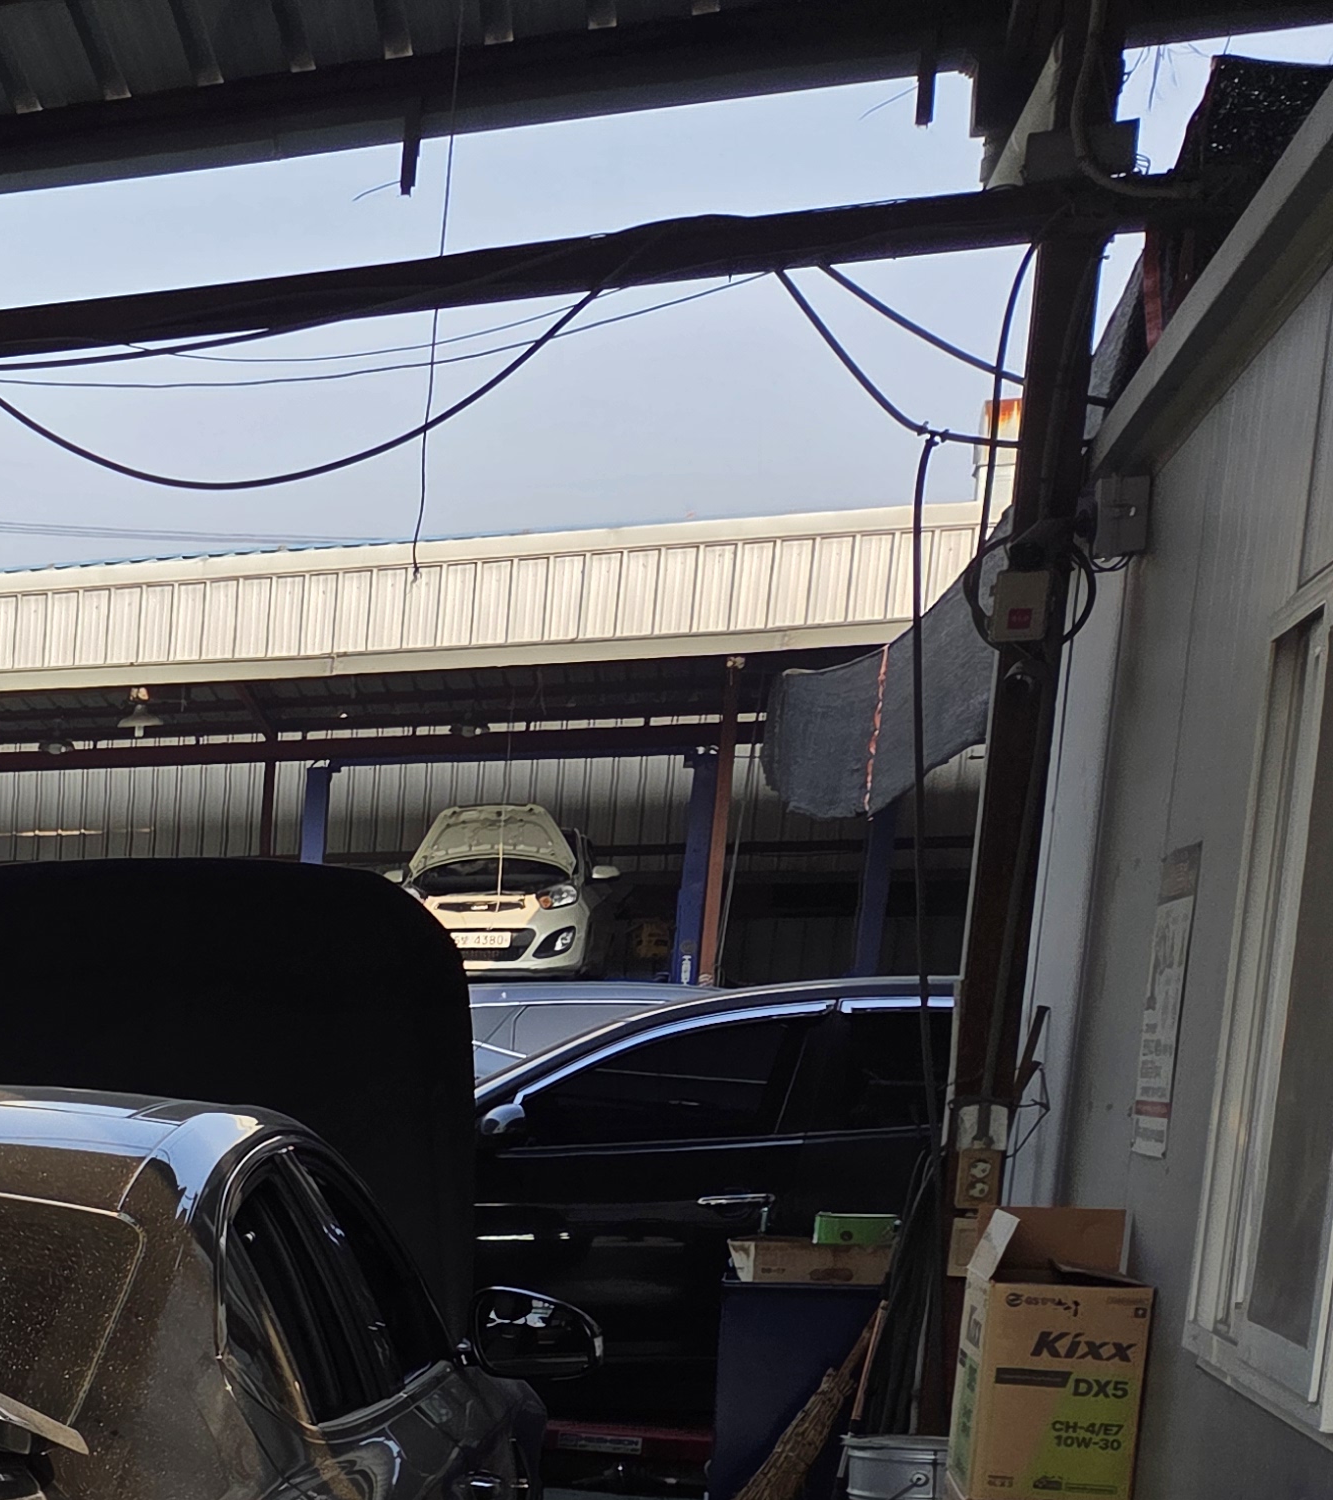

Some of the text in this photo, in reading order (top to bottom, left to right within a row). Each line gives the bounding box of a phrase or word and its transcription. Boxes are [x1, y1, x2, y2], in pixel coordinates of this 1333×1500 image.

[474, 935, 504, 945] 4380
[1030, 1330, 1137, 1362] Kixx
[1072, 1379, 1129, 1399] DX5
[1051, 1420, 1124, 1436] CH-4/E7
[1054, 1435, 1122, 1451] 10W-30
